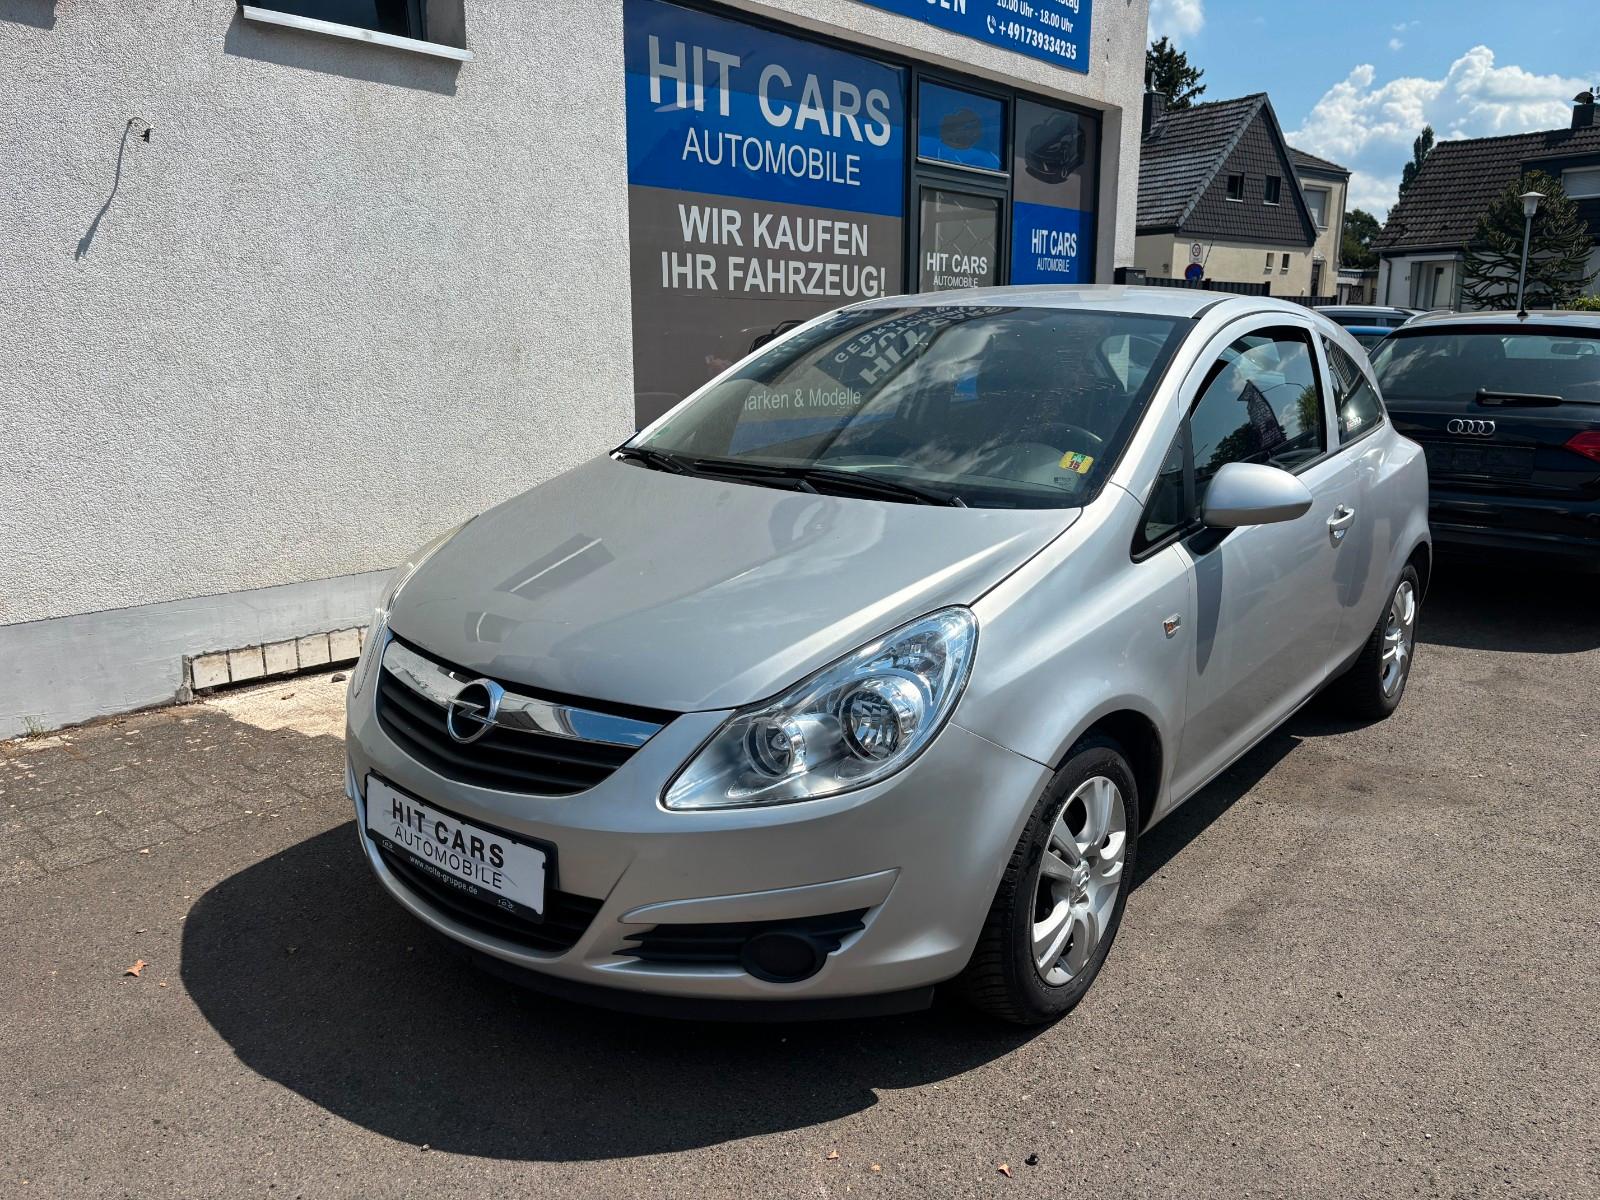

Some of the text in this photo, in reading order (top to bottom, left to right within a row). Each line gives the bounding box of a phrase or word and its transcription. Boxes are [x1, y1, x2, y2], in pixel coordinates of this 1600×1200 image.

[1020, 1, 1034, 18] Uhr
[1040, 9, 1060, 28] 18.00
[1061, 17, 1074, 33] Uhr
[649, 34, 891, 147] HIT CARS
[682, 127, 861, 186] AUTOMOBILE
[678, 203, 868, 257] WIR KAUFEN
[1032, 229, 1077, 258] HIT CARS
[661, 251, 886, 298] IHR FAHRZEUG!
[927, 252, 988, 275] HIT CARS
[933, 276, 979, 289] AUTOMOBILE
[1037, 257, 1070, 273] AUTOMOBILE
[744, 387, 861, 411] arken & Modelle
[392, 797, 504, 869] HIT CARS
[394, 825, 502, 890] AUTOMOBILE
